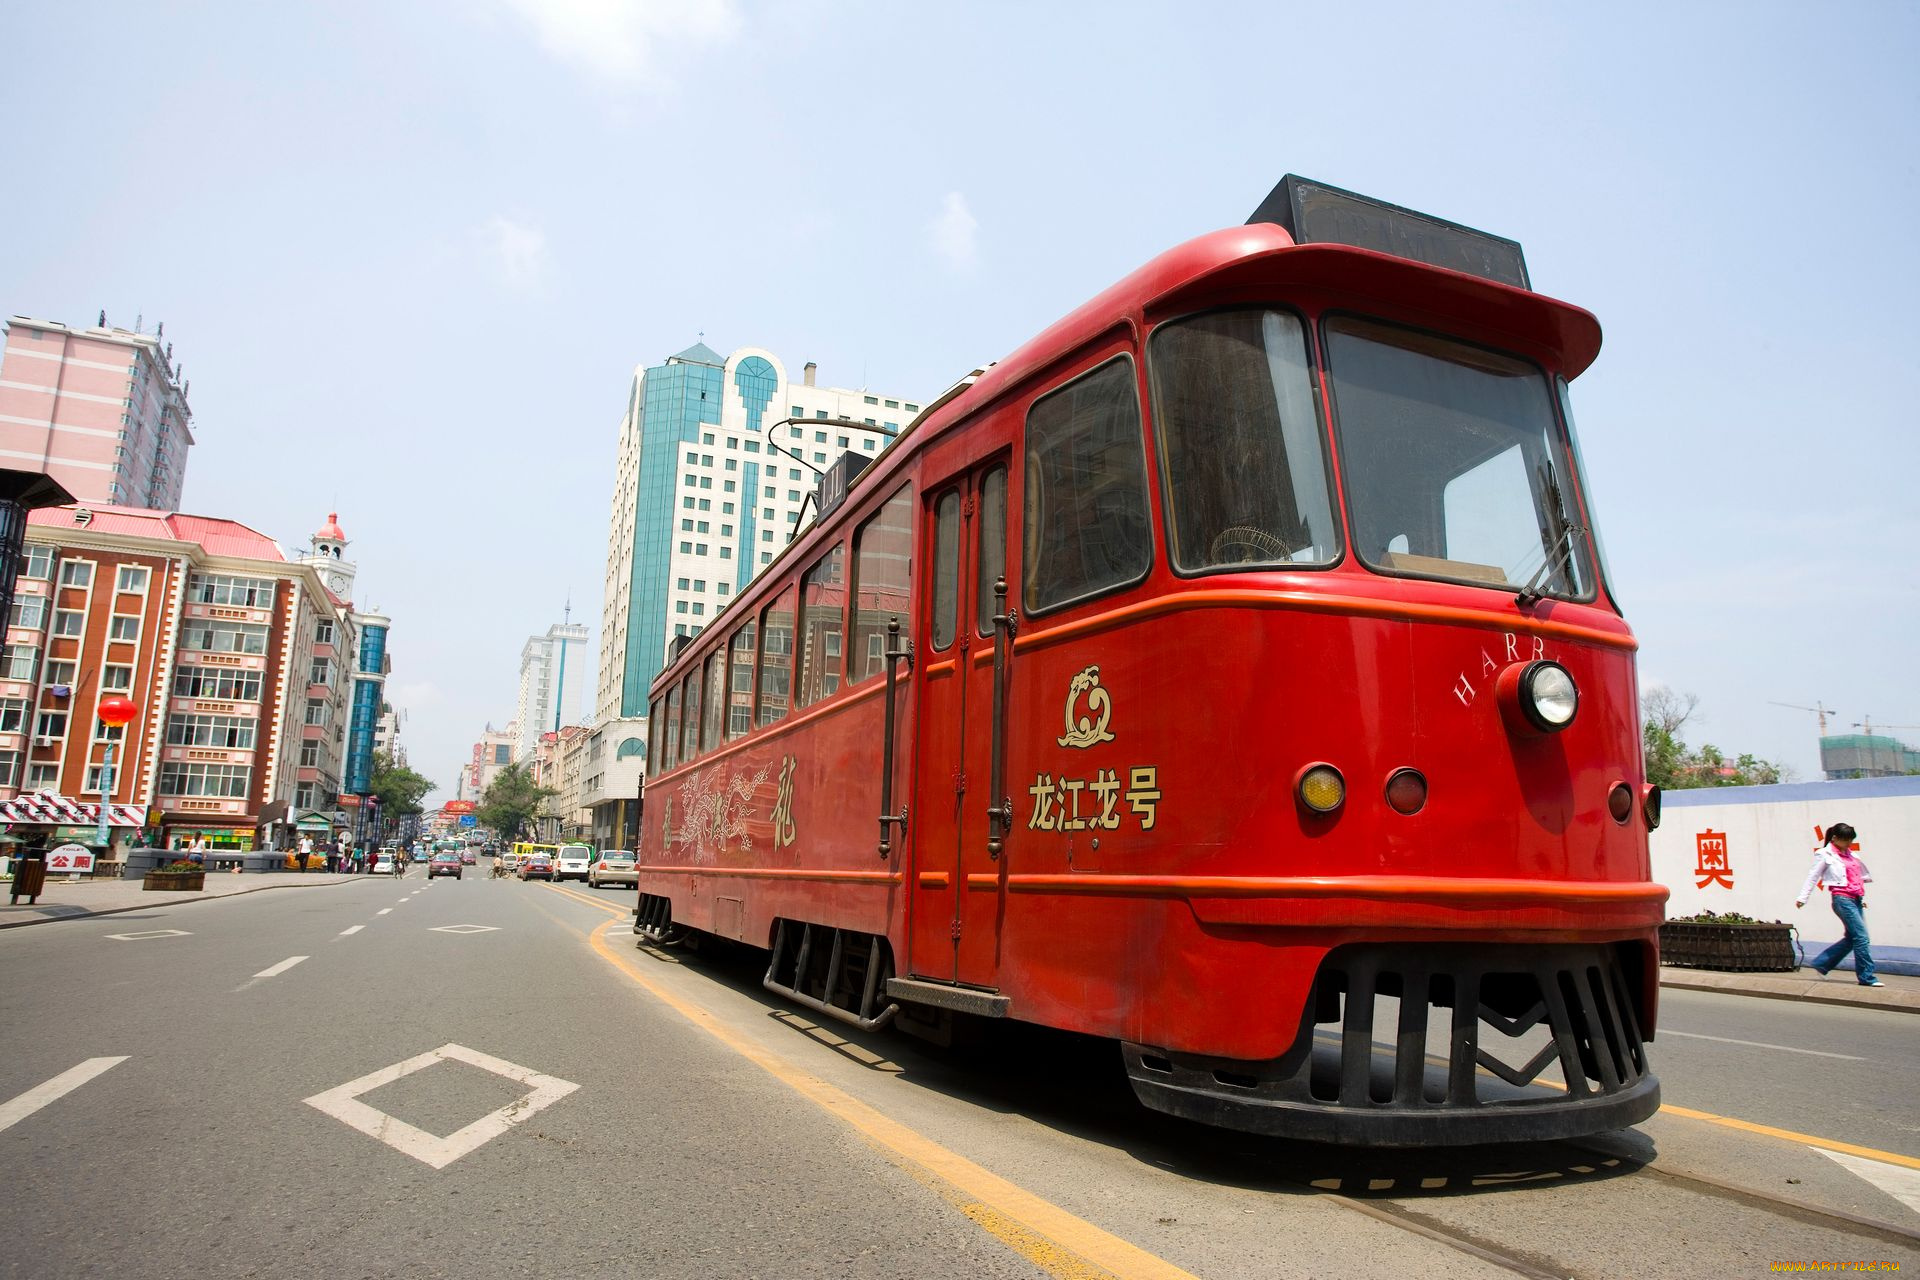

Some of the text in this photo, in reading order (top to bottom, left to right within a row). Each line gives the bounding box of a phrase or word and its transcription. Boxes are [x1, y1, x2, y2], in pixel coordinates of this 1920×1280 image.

[822, 464, 842, 511] LJL
[1453, 632, 1582, 708] HARB
[1028, 765, 1161, 832] 龙江龙号
